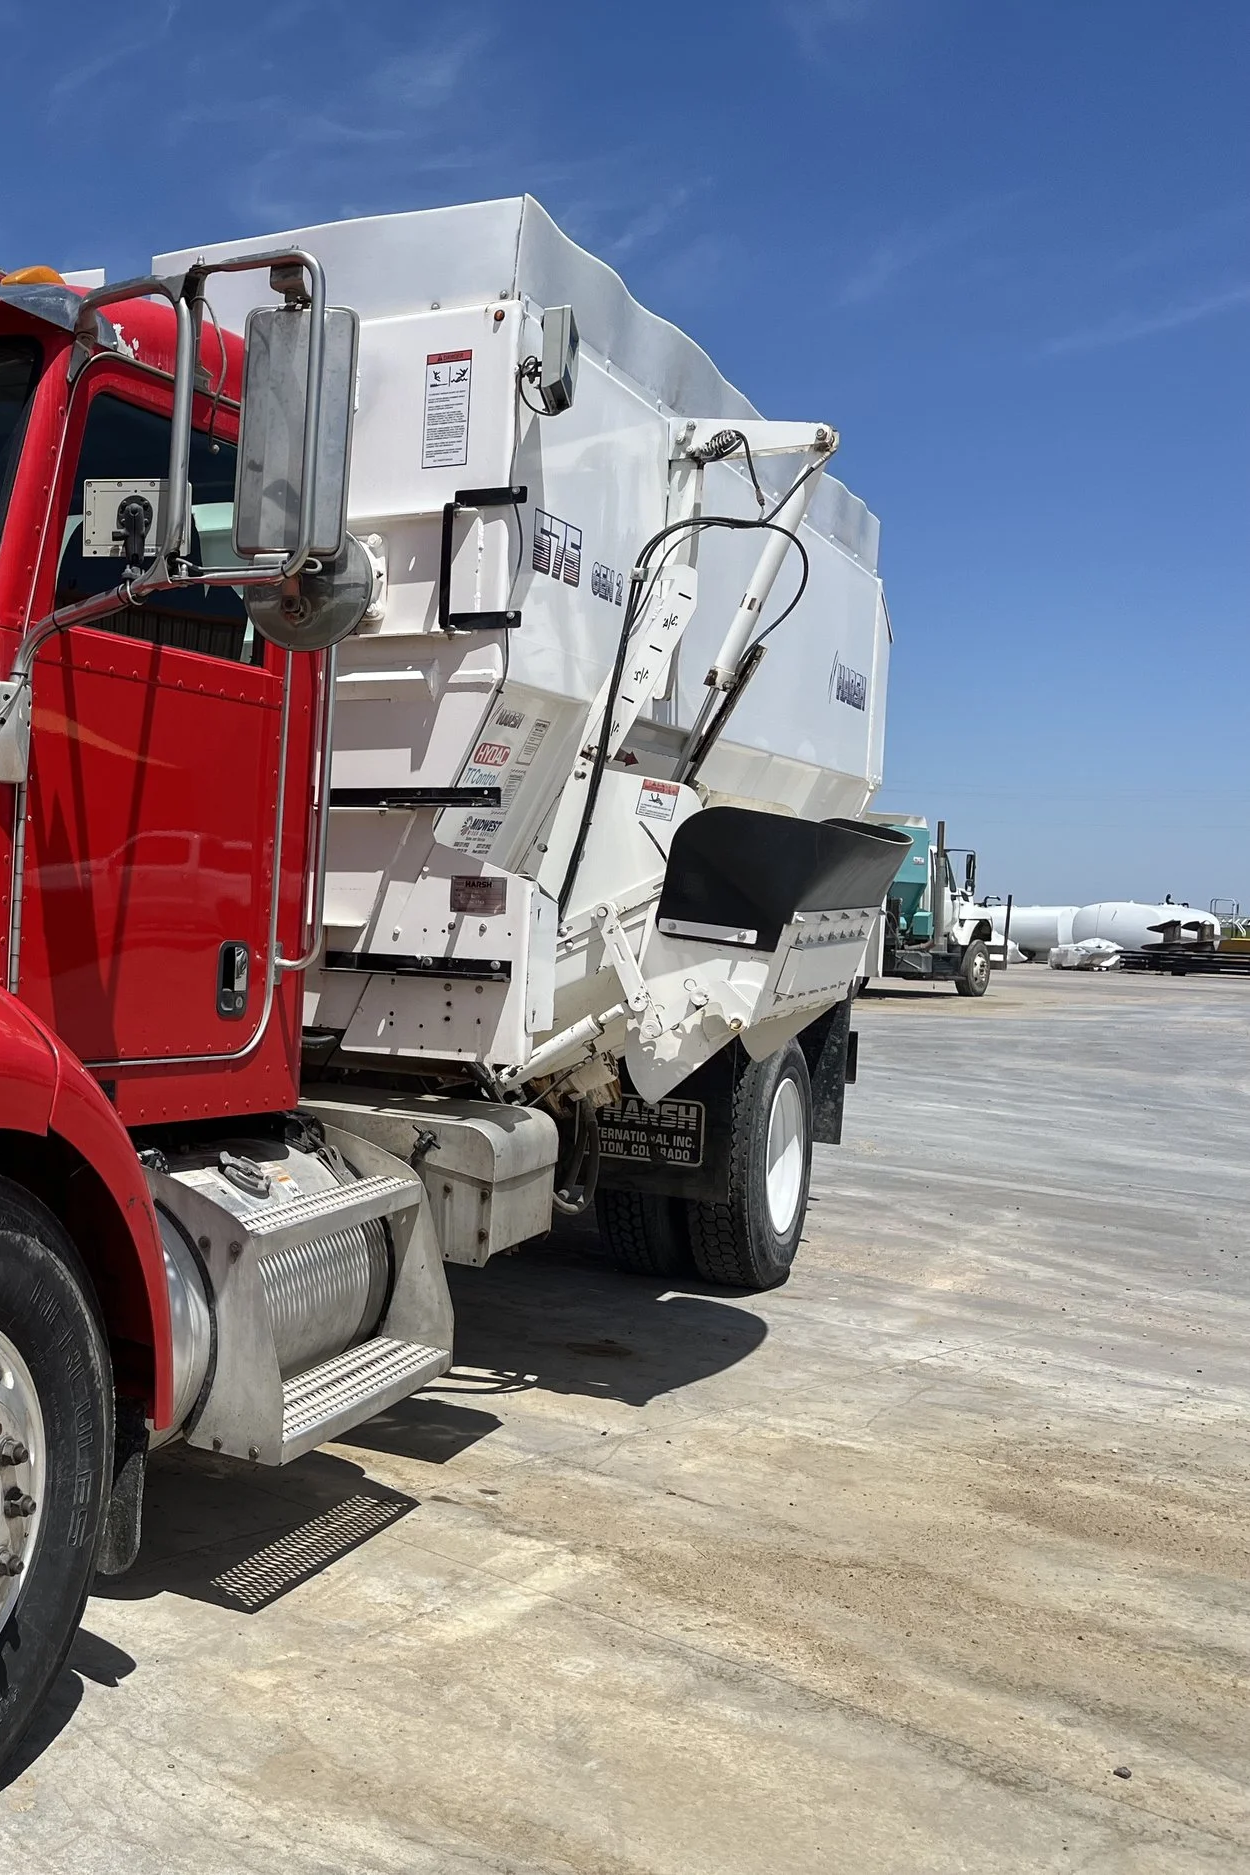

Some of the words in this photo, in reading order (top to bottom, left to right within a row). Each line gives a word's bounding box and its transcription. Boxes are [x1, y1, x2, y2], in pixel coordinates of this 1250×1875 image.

[532, 507, 582, 588] 575
[591, 561, 615, 603] GEN
[614, 573, 624, 607] 2
[475, 743, 510, 765] HYDAC
[470, 818, 503, 832] MIDWEST
[465, 880, 493, 889] HARSH
[603, 1099, 698, 1130] HARSH
[631, 1143, 691, 1161] COLRADO
[673, 1135, 696, 1149] INC.
